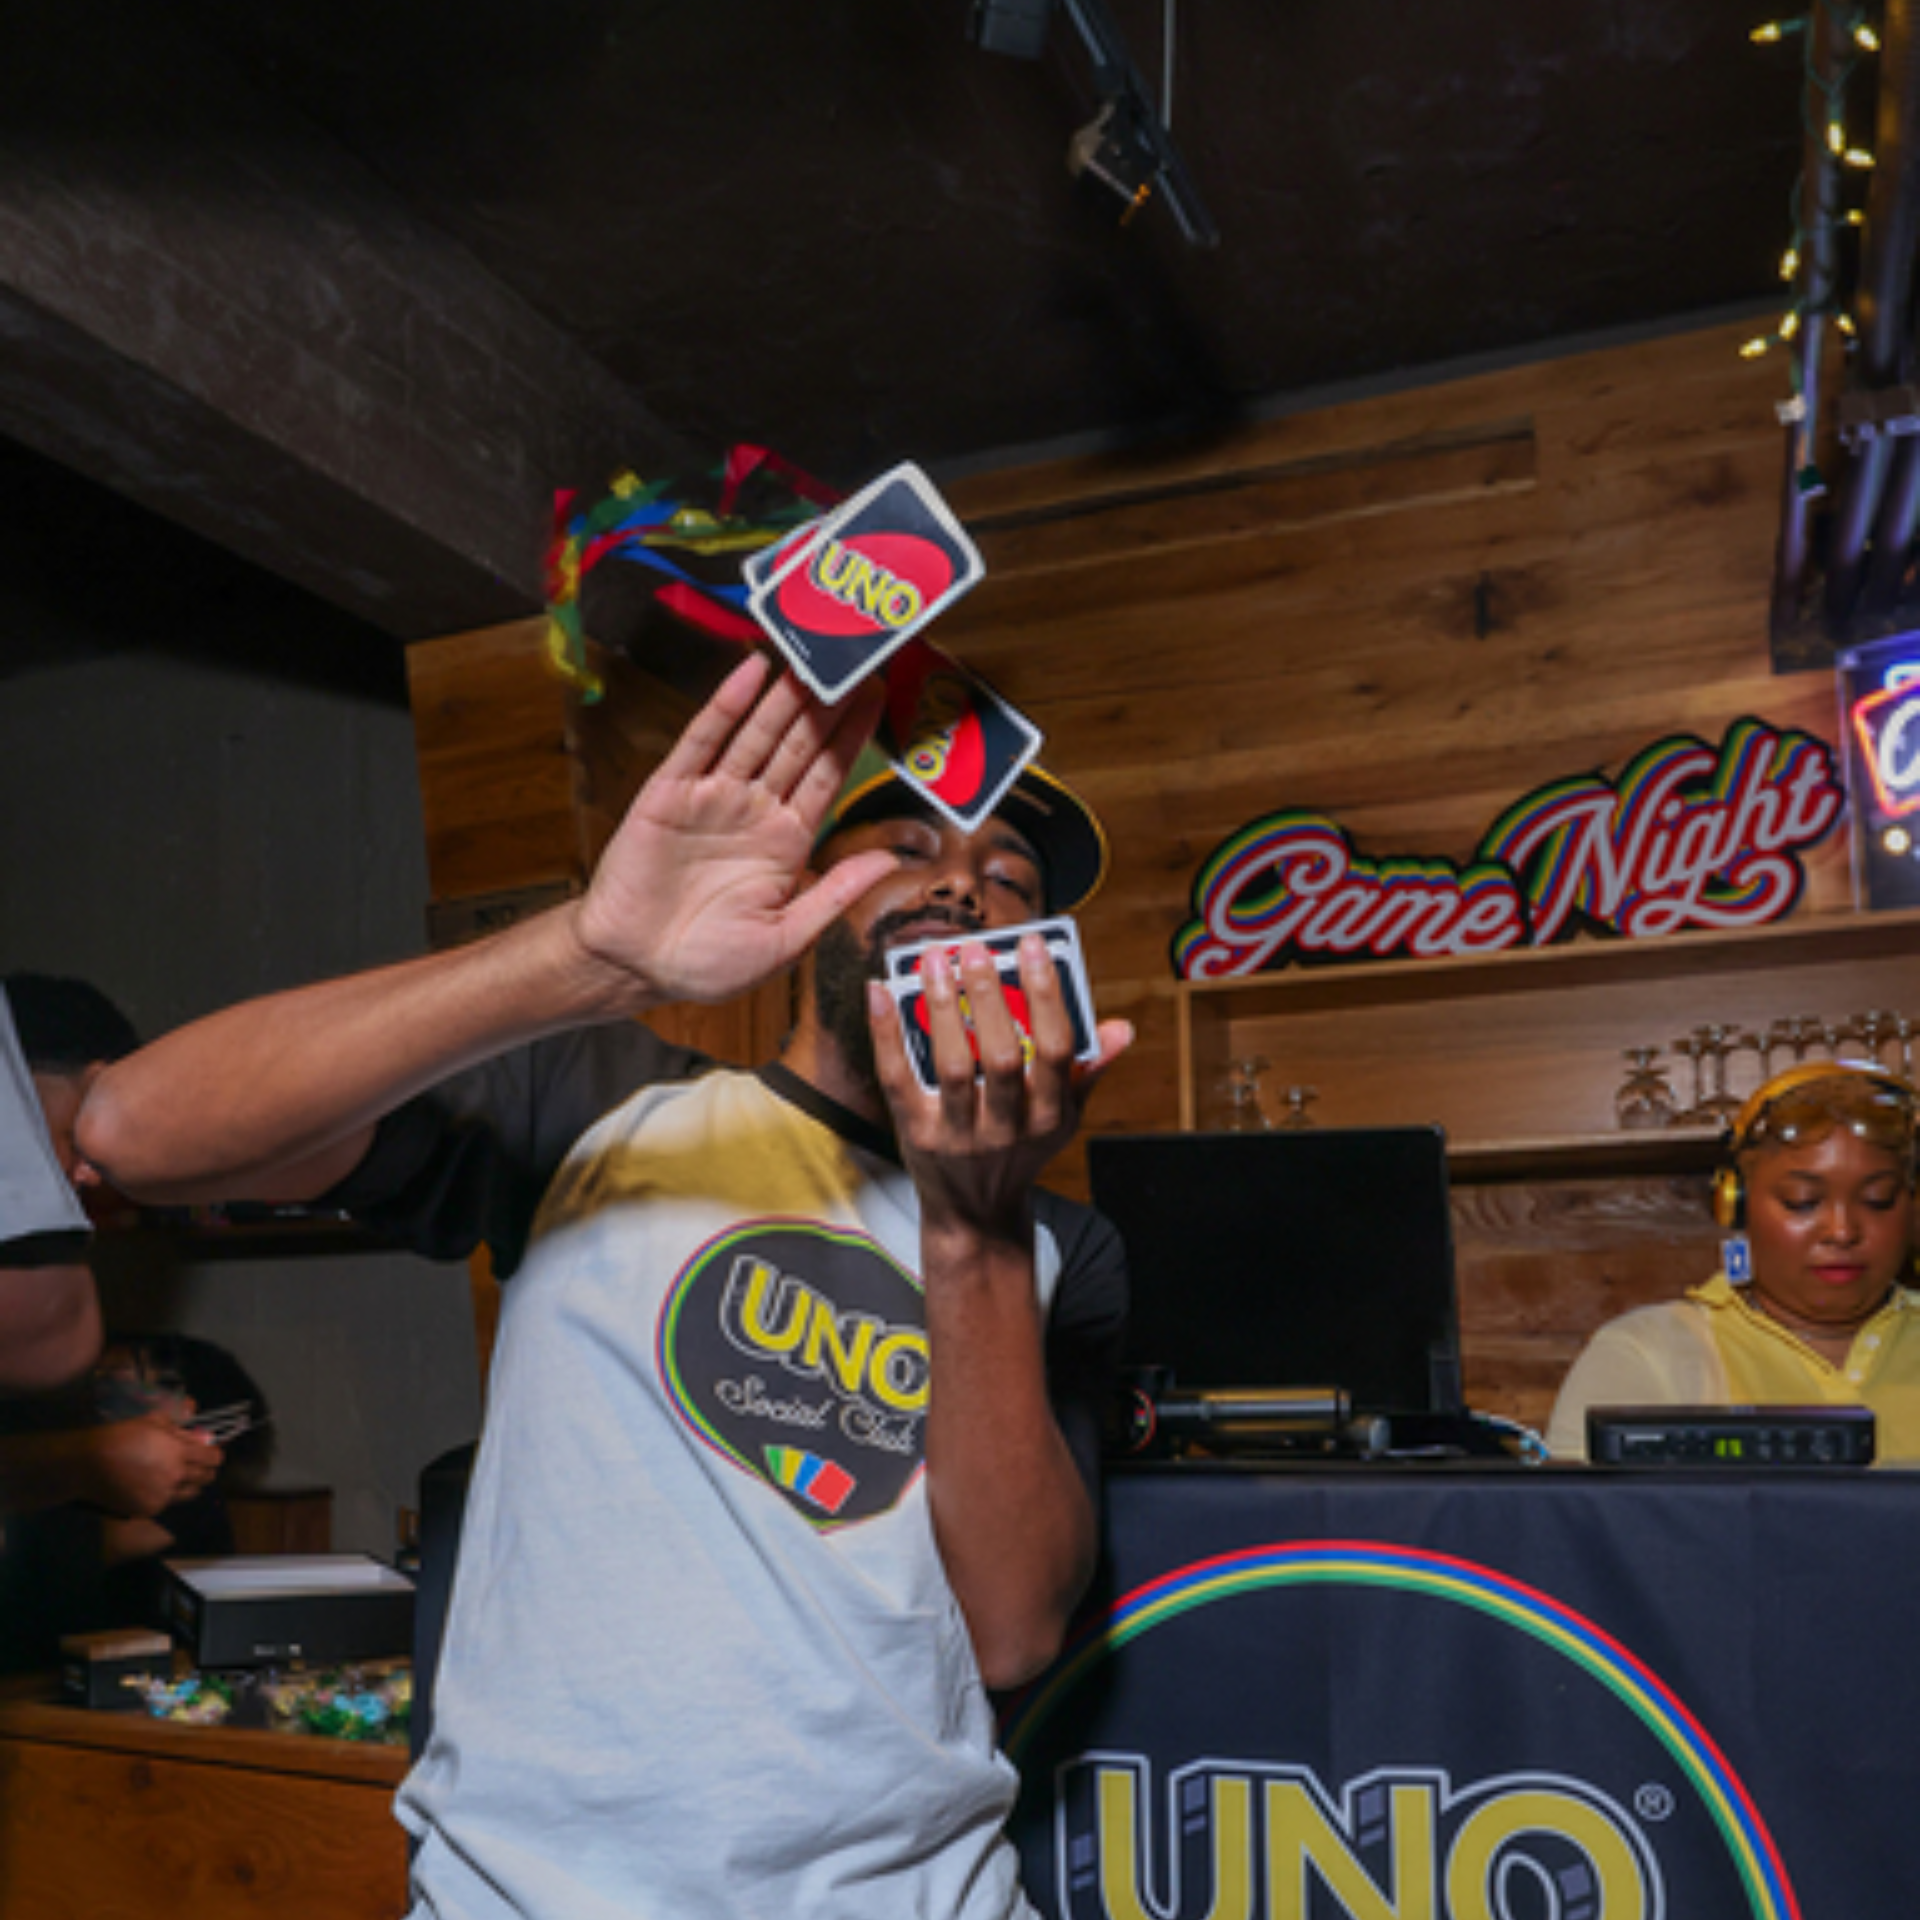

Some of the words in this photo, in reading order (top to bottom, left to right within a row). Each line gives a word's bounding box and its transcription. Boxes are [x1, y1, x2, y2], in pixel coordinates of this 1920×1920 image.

[810, 538, 924, 630] UNO
[1185, 832, 1524, 981] Game
[1502, 732, 1842, 946] Night
[719, 1253, 931, 1412] UNO
[714, 1375, 836, 1429] Social
[839, 1404, 917, 1456] Club
[1057, 1753, 1664, 1920] UNO
